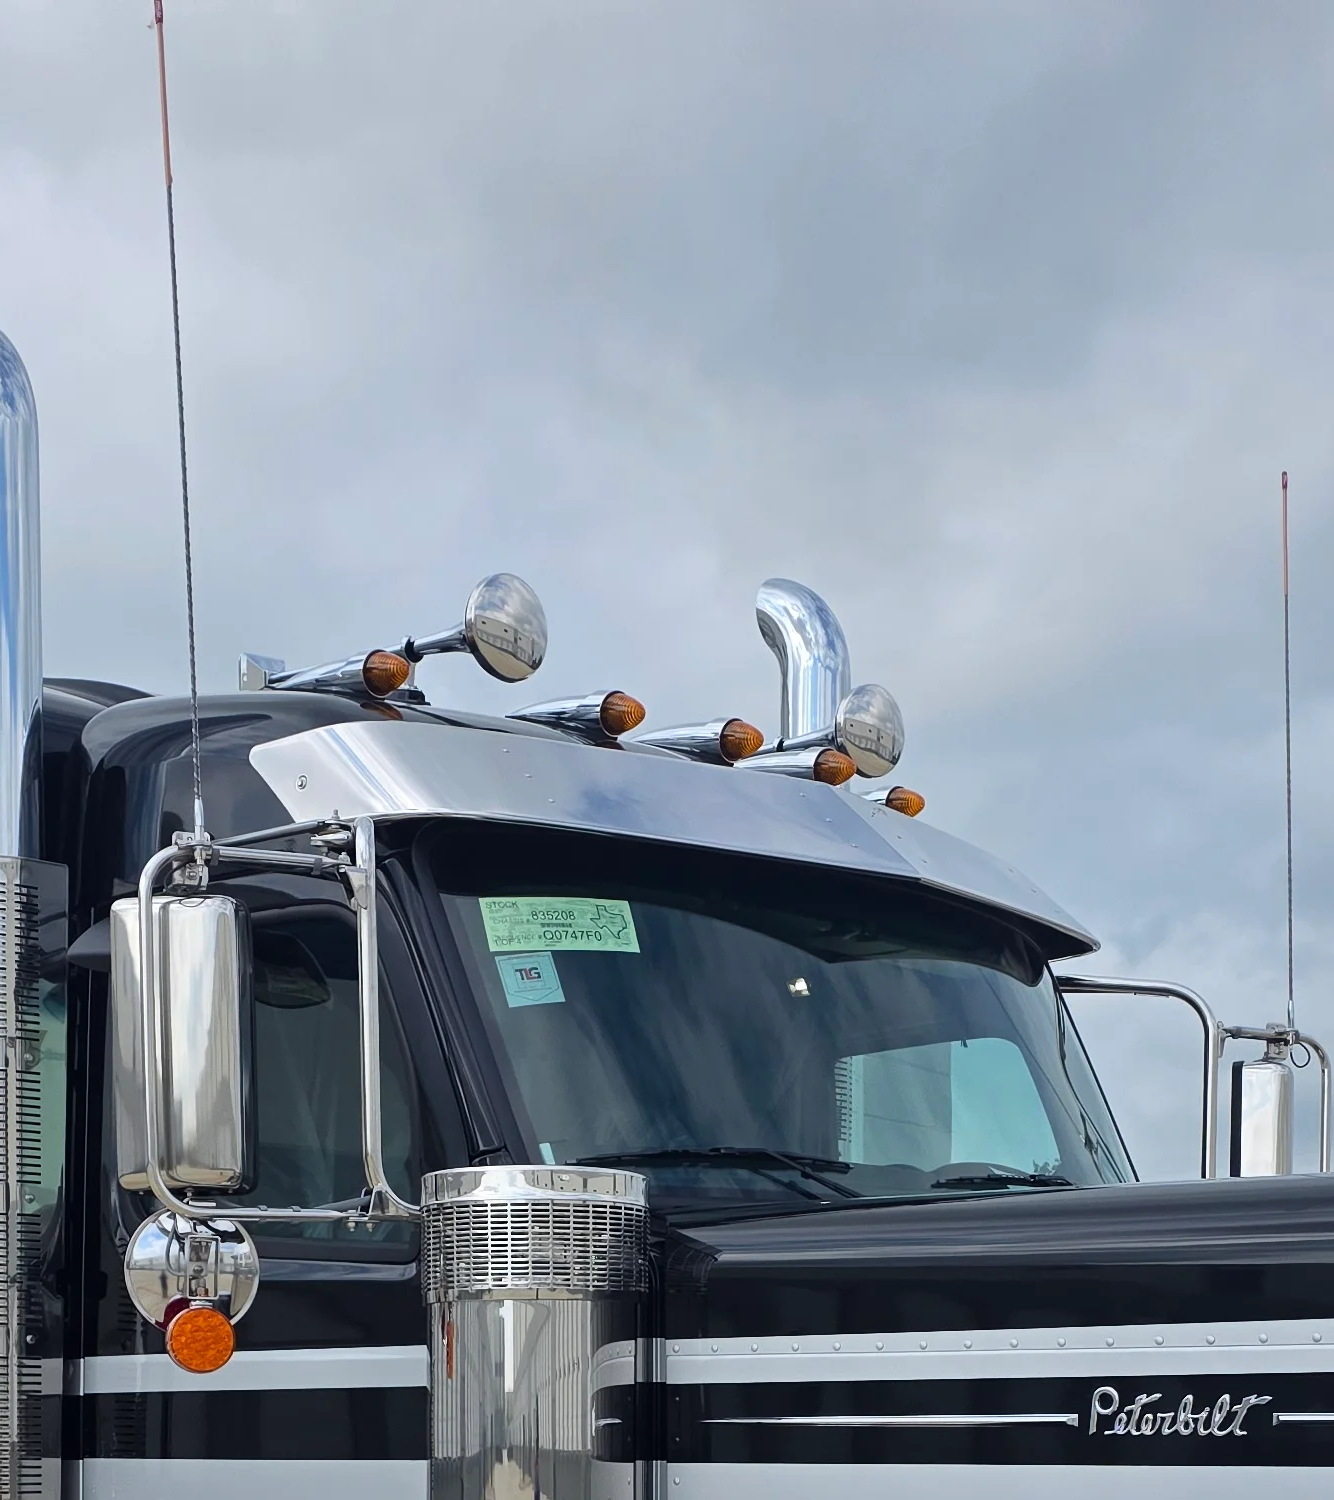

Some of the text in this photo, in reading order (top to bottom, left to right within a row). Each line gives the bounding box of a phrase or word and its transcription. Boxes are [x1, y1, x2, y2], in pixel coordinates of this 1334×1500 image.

[485, 900, 518, 909] STOCK
[530, 910, 576, 921] 835208
[543, 930, 602, 941] Q0747F0
[515, 966, 542, 981] TLG
[1089, 1386, 1273, 1436] Peterbilt
